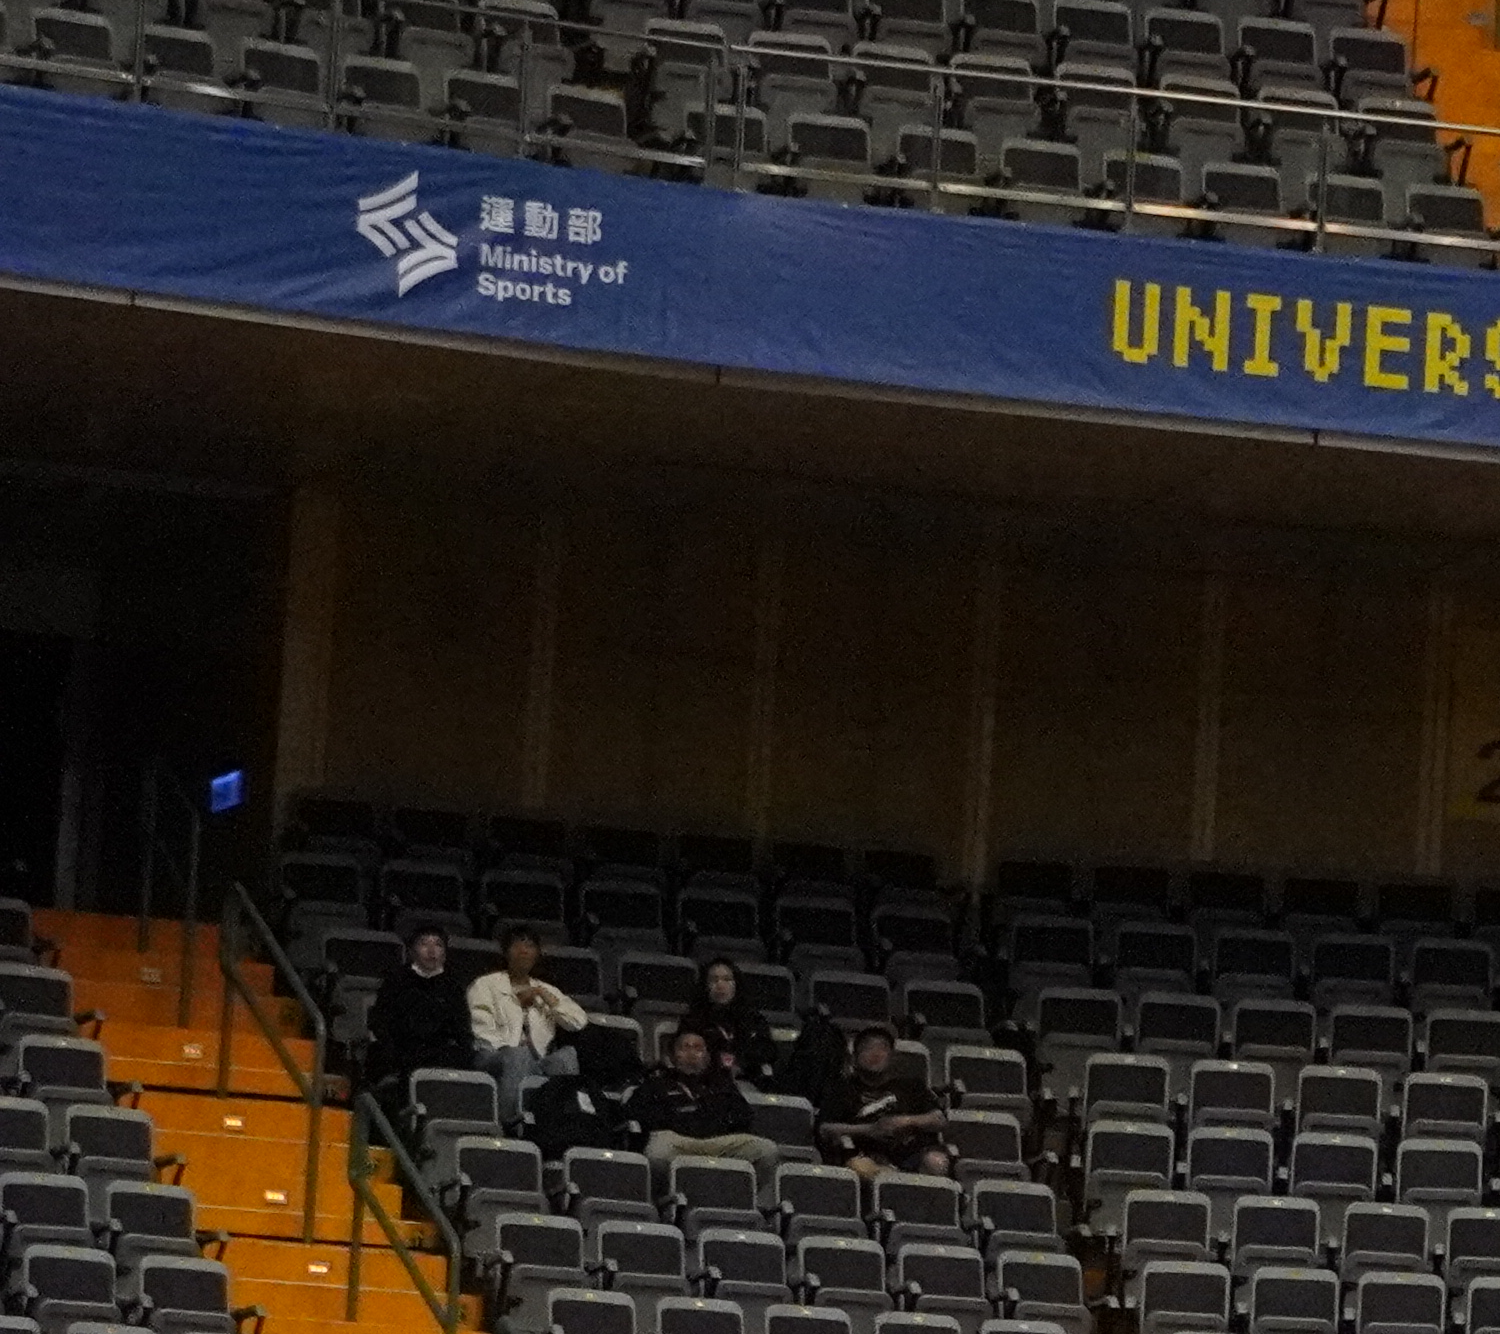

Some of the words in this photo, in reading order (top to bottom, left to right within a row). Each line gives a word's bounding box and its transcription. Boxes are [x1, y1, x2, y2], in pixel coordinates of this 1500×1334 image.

[479, 194, 602, 245] 運動部
[480, 243, 594, 285] Ministry
[600, 260, 629, 285] of
[477, 272, 572, 306] Sports
